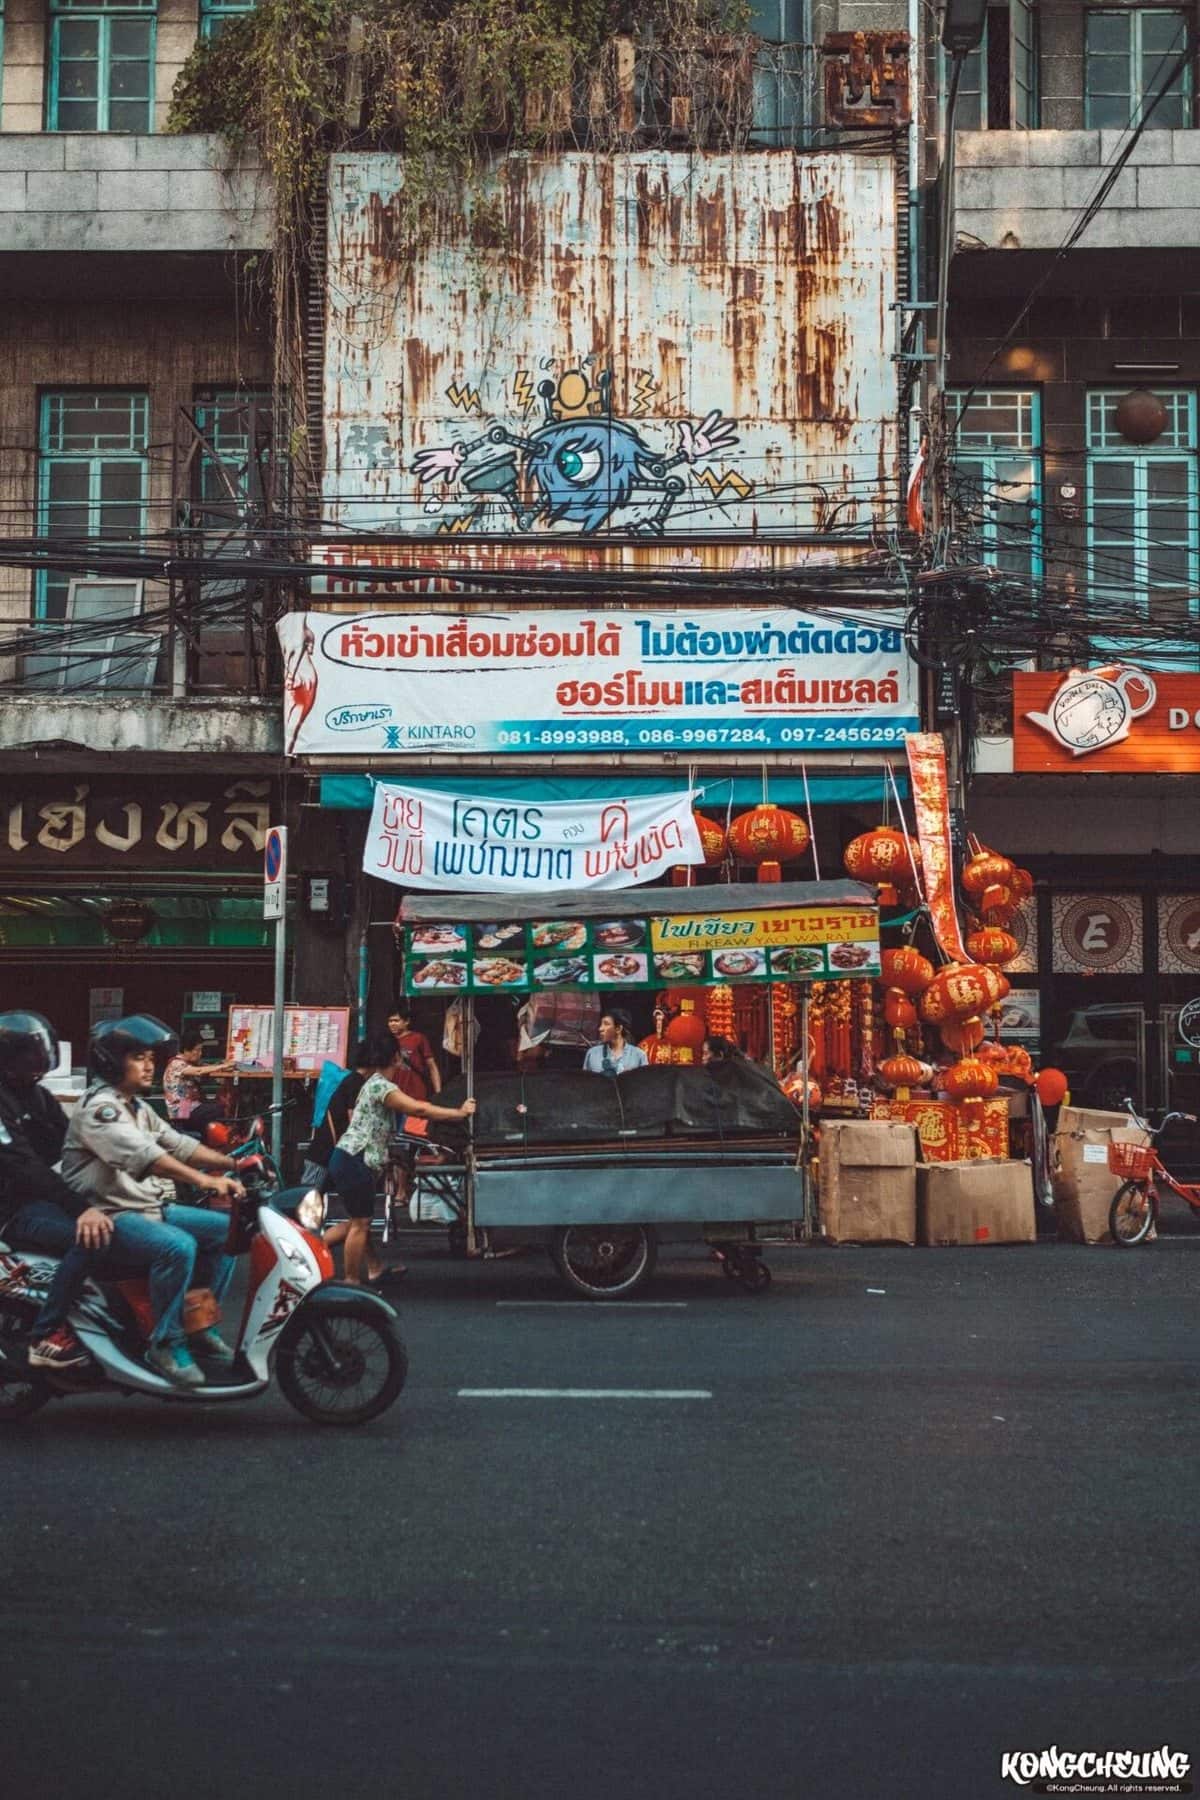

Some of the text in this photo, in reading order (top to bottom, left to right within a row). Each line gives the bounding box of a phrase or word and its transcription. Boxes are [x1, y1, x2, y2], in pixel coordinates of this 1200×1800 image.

[340, 618, 623, 658] หัวเข่าเสื่อมซ่อมได้
[1169, 708, 1200, 729] D
[408, 725, 476, 739] KINTARO
[497, 729, 630, 746] 081-8993988,
[638, 728, 770, 745] 086-9967284,
[762, 914, 876, 933] เยาวราช
[755, 935, 788, 945] YAO
